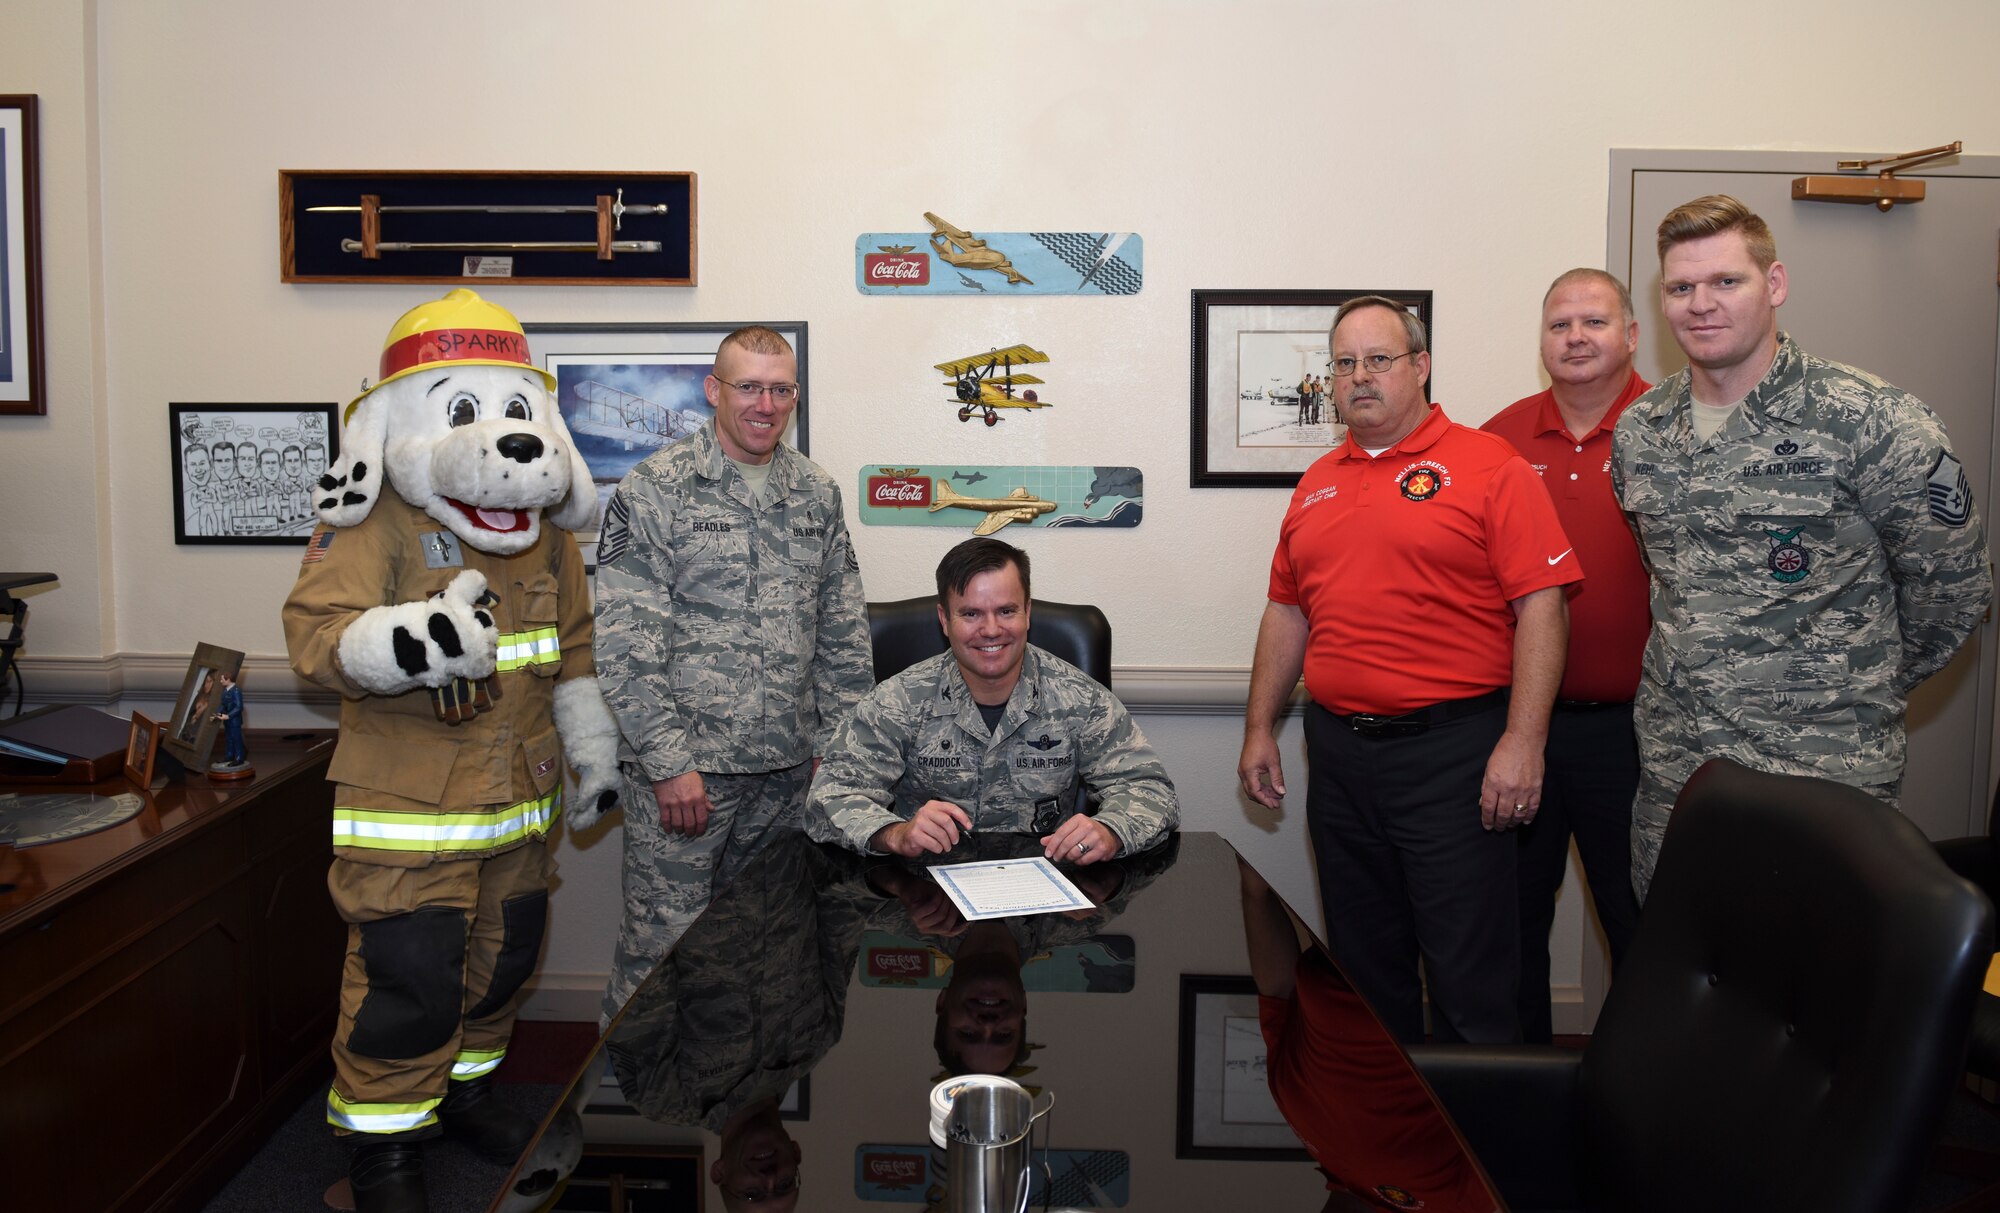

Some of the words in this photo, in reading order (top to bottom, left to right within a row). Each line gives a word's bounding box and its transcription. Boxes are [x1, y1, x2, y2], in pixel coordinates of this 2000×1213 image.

[872, 261, 921, 279] Coca-Cola
[438, 333, 519, 355] SPARKY
[1743, 464, 1762, 477] U.S.
[1766, 463, 1783, 476] AIR
[1786, 461, 1824, 475] FORCE
[875, 484, 924, 501] Coca-Cola
[693, 521, 731, 533] BEADLES
[805, 527, 816, 537] AIR
[917, 756, 961, 768] CRADDOCK
[1016, 757, 1030, 769] U.S.
[1032, 757, 1046, 769] AIR
[1048, 754, 1072, 769] FORCE
